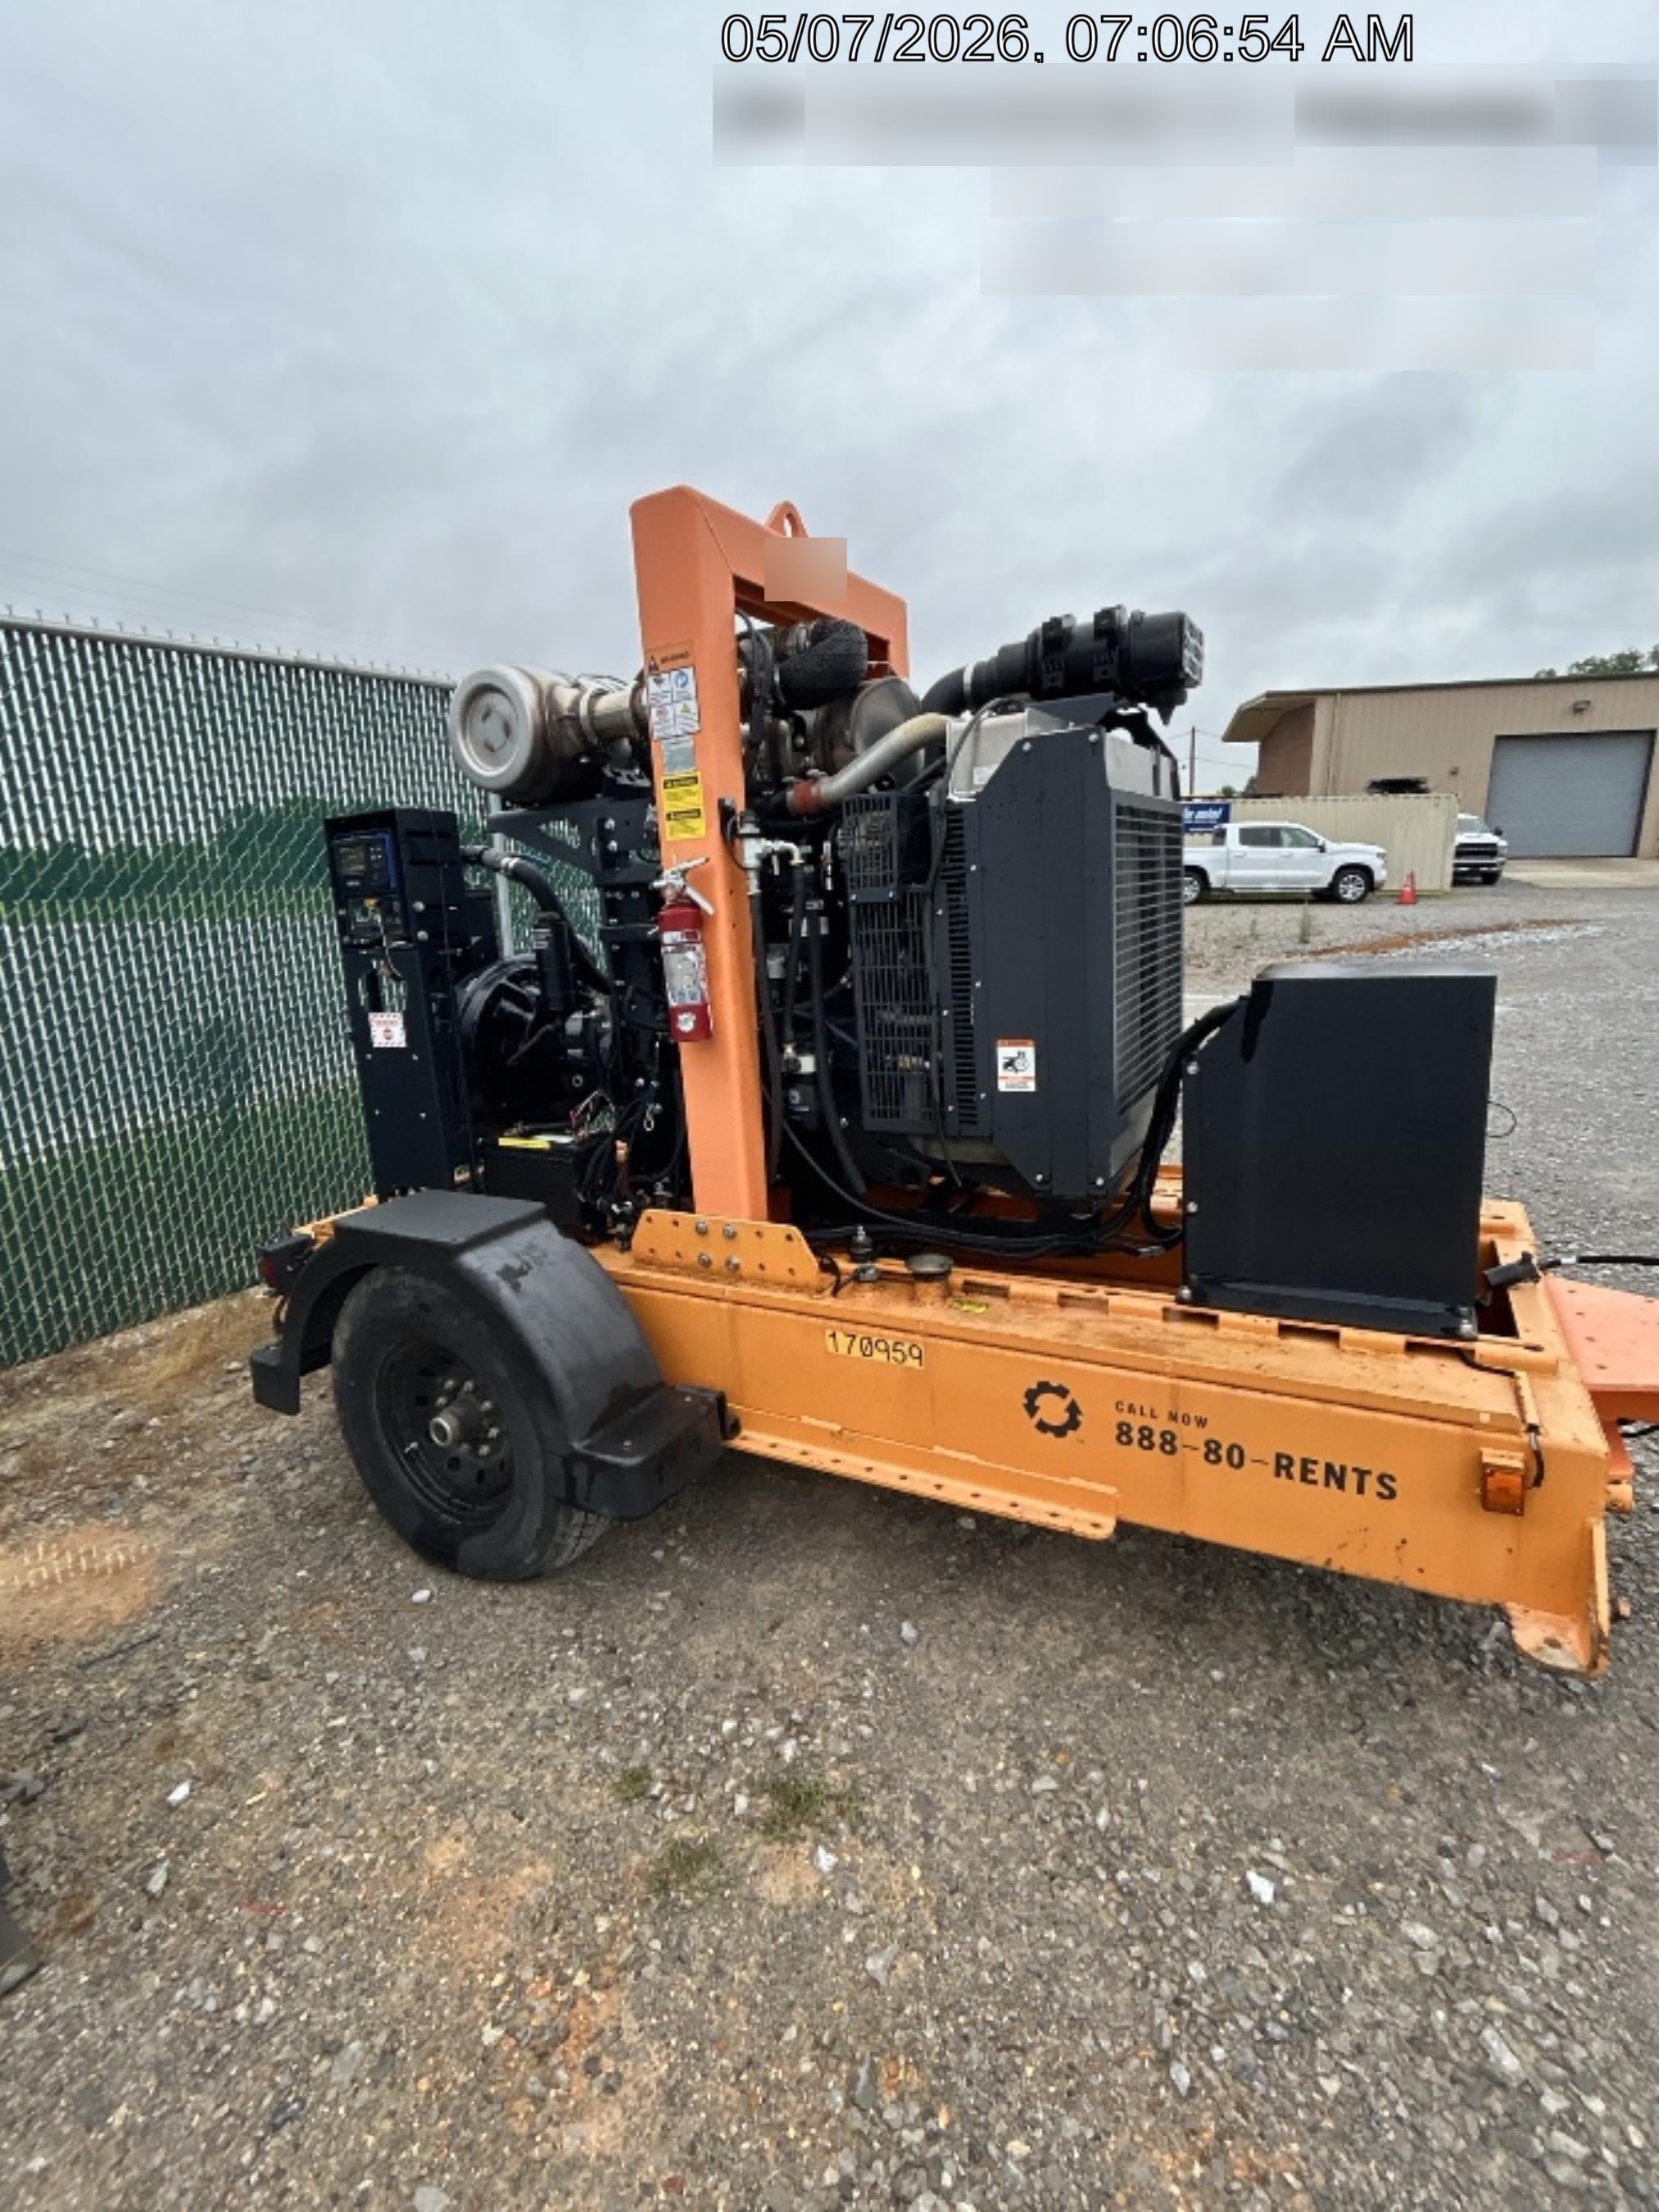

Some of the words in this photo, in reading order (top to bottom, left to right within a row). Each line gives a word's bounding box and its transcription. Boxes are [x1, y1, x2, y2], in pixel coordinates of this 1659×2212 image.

[827, 1330, 924, 1367] 170959
[1115, 1400, 1158, 1420] CALL
[1167, 1409, 1208, 1429] NOW
[1115, 1421, 1398, 1502] 888-80-RENTS
